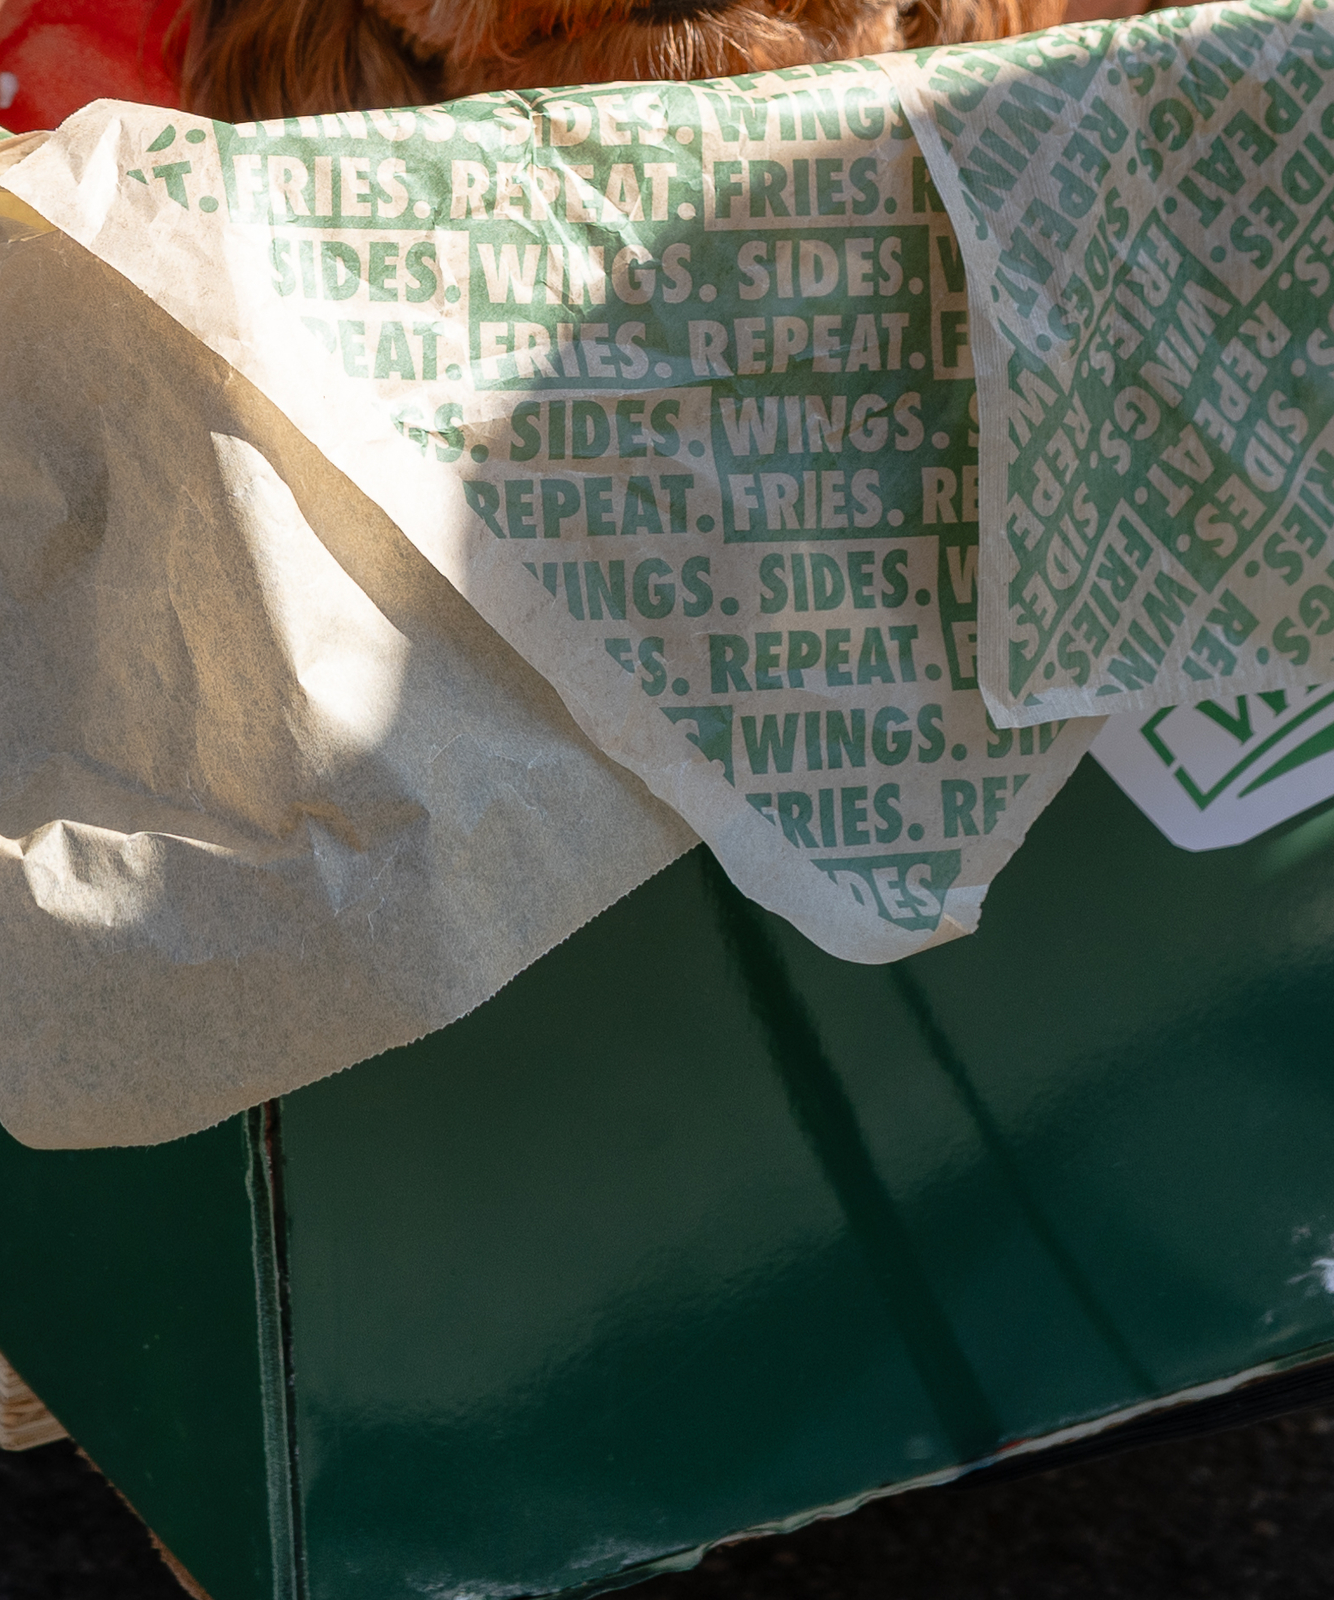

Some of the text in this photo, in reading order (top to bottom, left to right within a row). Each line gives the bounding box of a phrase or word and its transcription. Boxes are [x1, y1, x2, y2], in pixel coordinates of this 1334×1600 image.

[493, 92, 694, 147] SIDES.
[1126, 8, 1276, 183] WINGS.
[233, 154, 431, 219] FRIES.
[450, 159, 696, 222] REPEAT.
[713, 156, 897, 218] FRIES.
[988, 94, 1131, 320] REPEAT.
[269, 238, 461, 304] SIDES.
[477, 241, 717, 305] WINGS.
[738, 236, 924, 299] SIDES.
[1035, 186, 1134, 363] SIDES.
[1079, 221, 1182, 387] FRIES.
[479, 321, 671, 380] FRIES.
[689, 313, 926, 376] REPEAT.
[1088, 277, 1232, 476] WINGS.
[509, 400, 705, 462] SIDES.
[719, 393, 950, 457] WINGS.
[1134, 299, 1292, 519] REPEAT.
[467, 474, 715, 539] REPEAT.
[726, 467, 905, 531] FRIES.
[1176, 387, 1314, 559] SIDES.
[758, 548, 932, 615] SIDES.
[1043, 513, 1155, 689] FRIES.
[708, 624, 942, 694] REPEAT.
[740, 703, 967, 774] WINGS.
